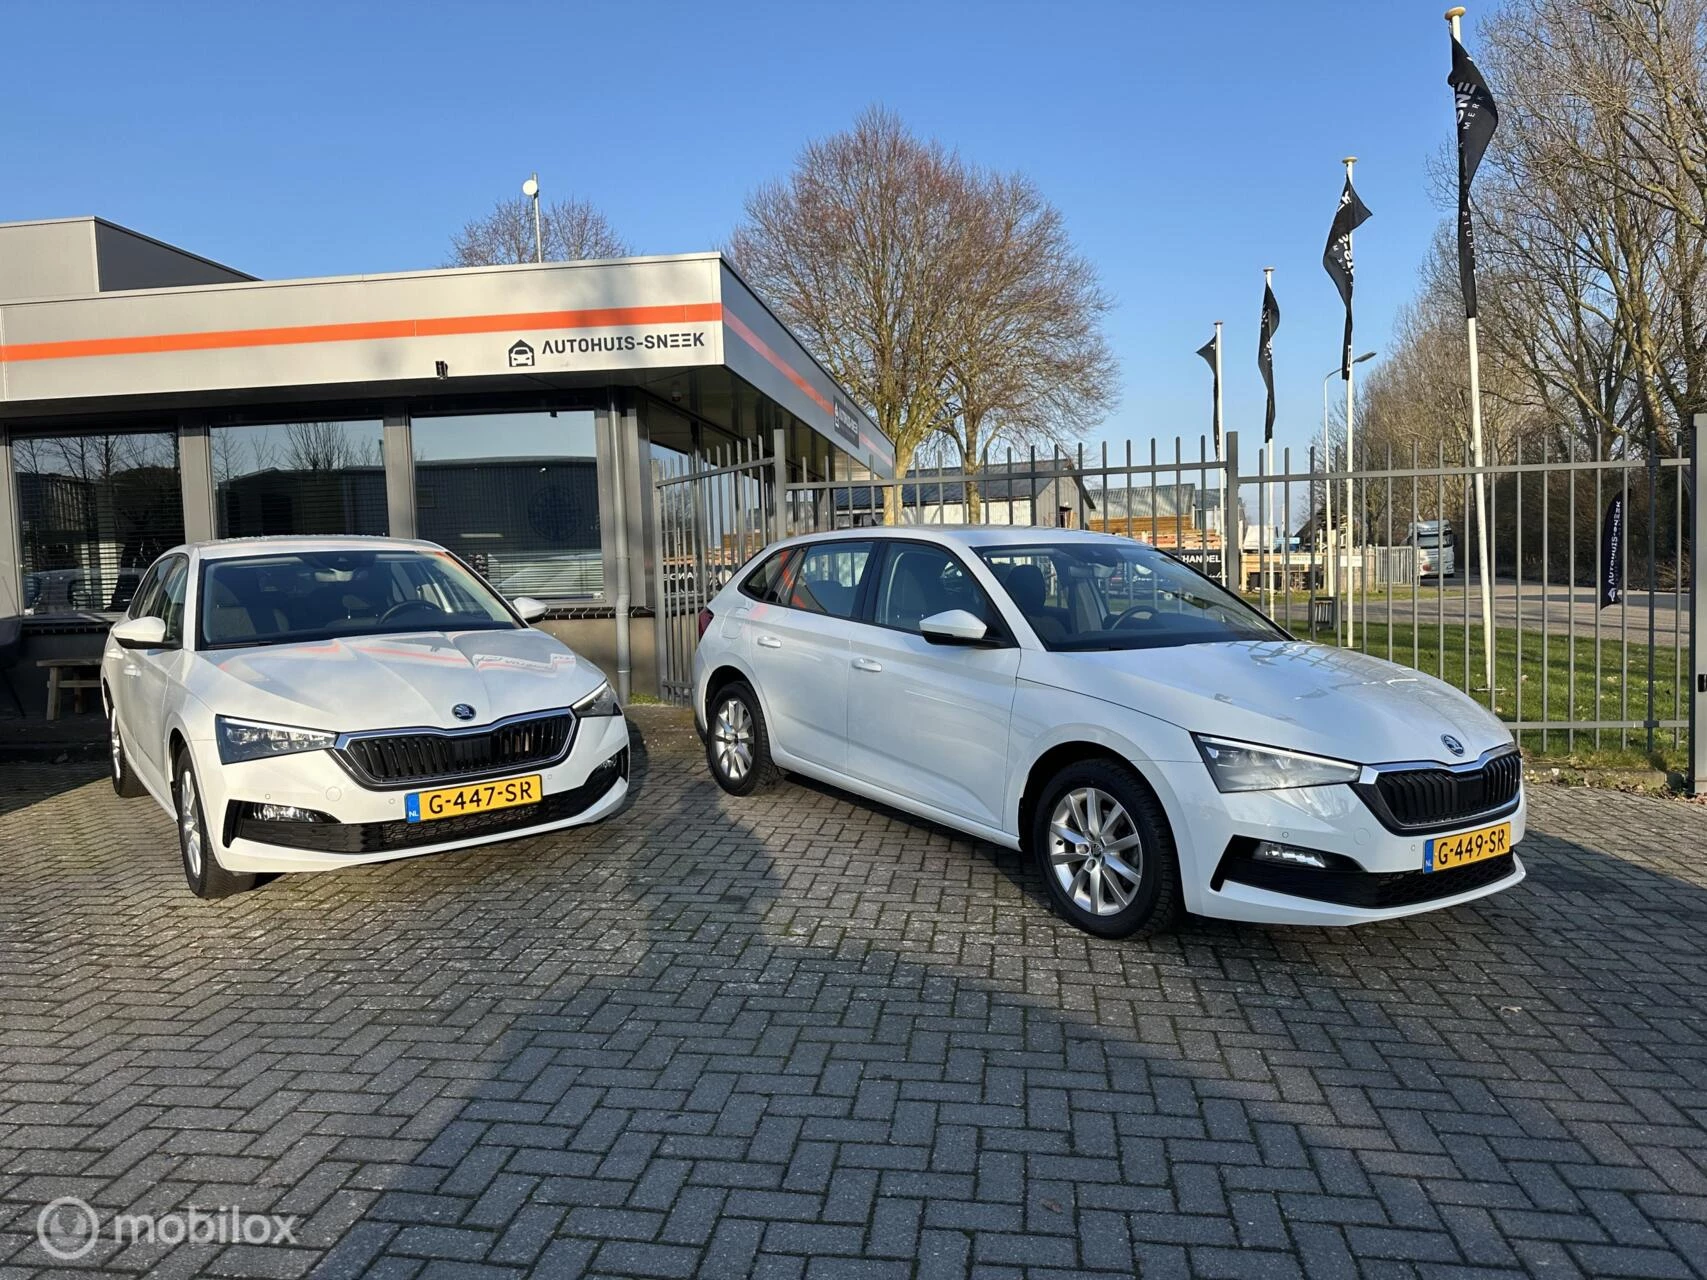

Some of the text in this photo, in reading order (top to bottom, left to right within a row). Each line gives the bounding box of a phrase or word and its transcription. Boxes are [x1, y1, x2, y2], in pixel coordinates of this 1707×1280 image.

[542, 332, 705, 355] AUTOHUIS-SNEEK
[408, 780, 533, 818] NL G-447-SR
[1438, 828, 1505, 865] G-449-SR
